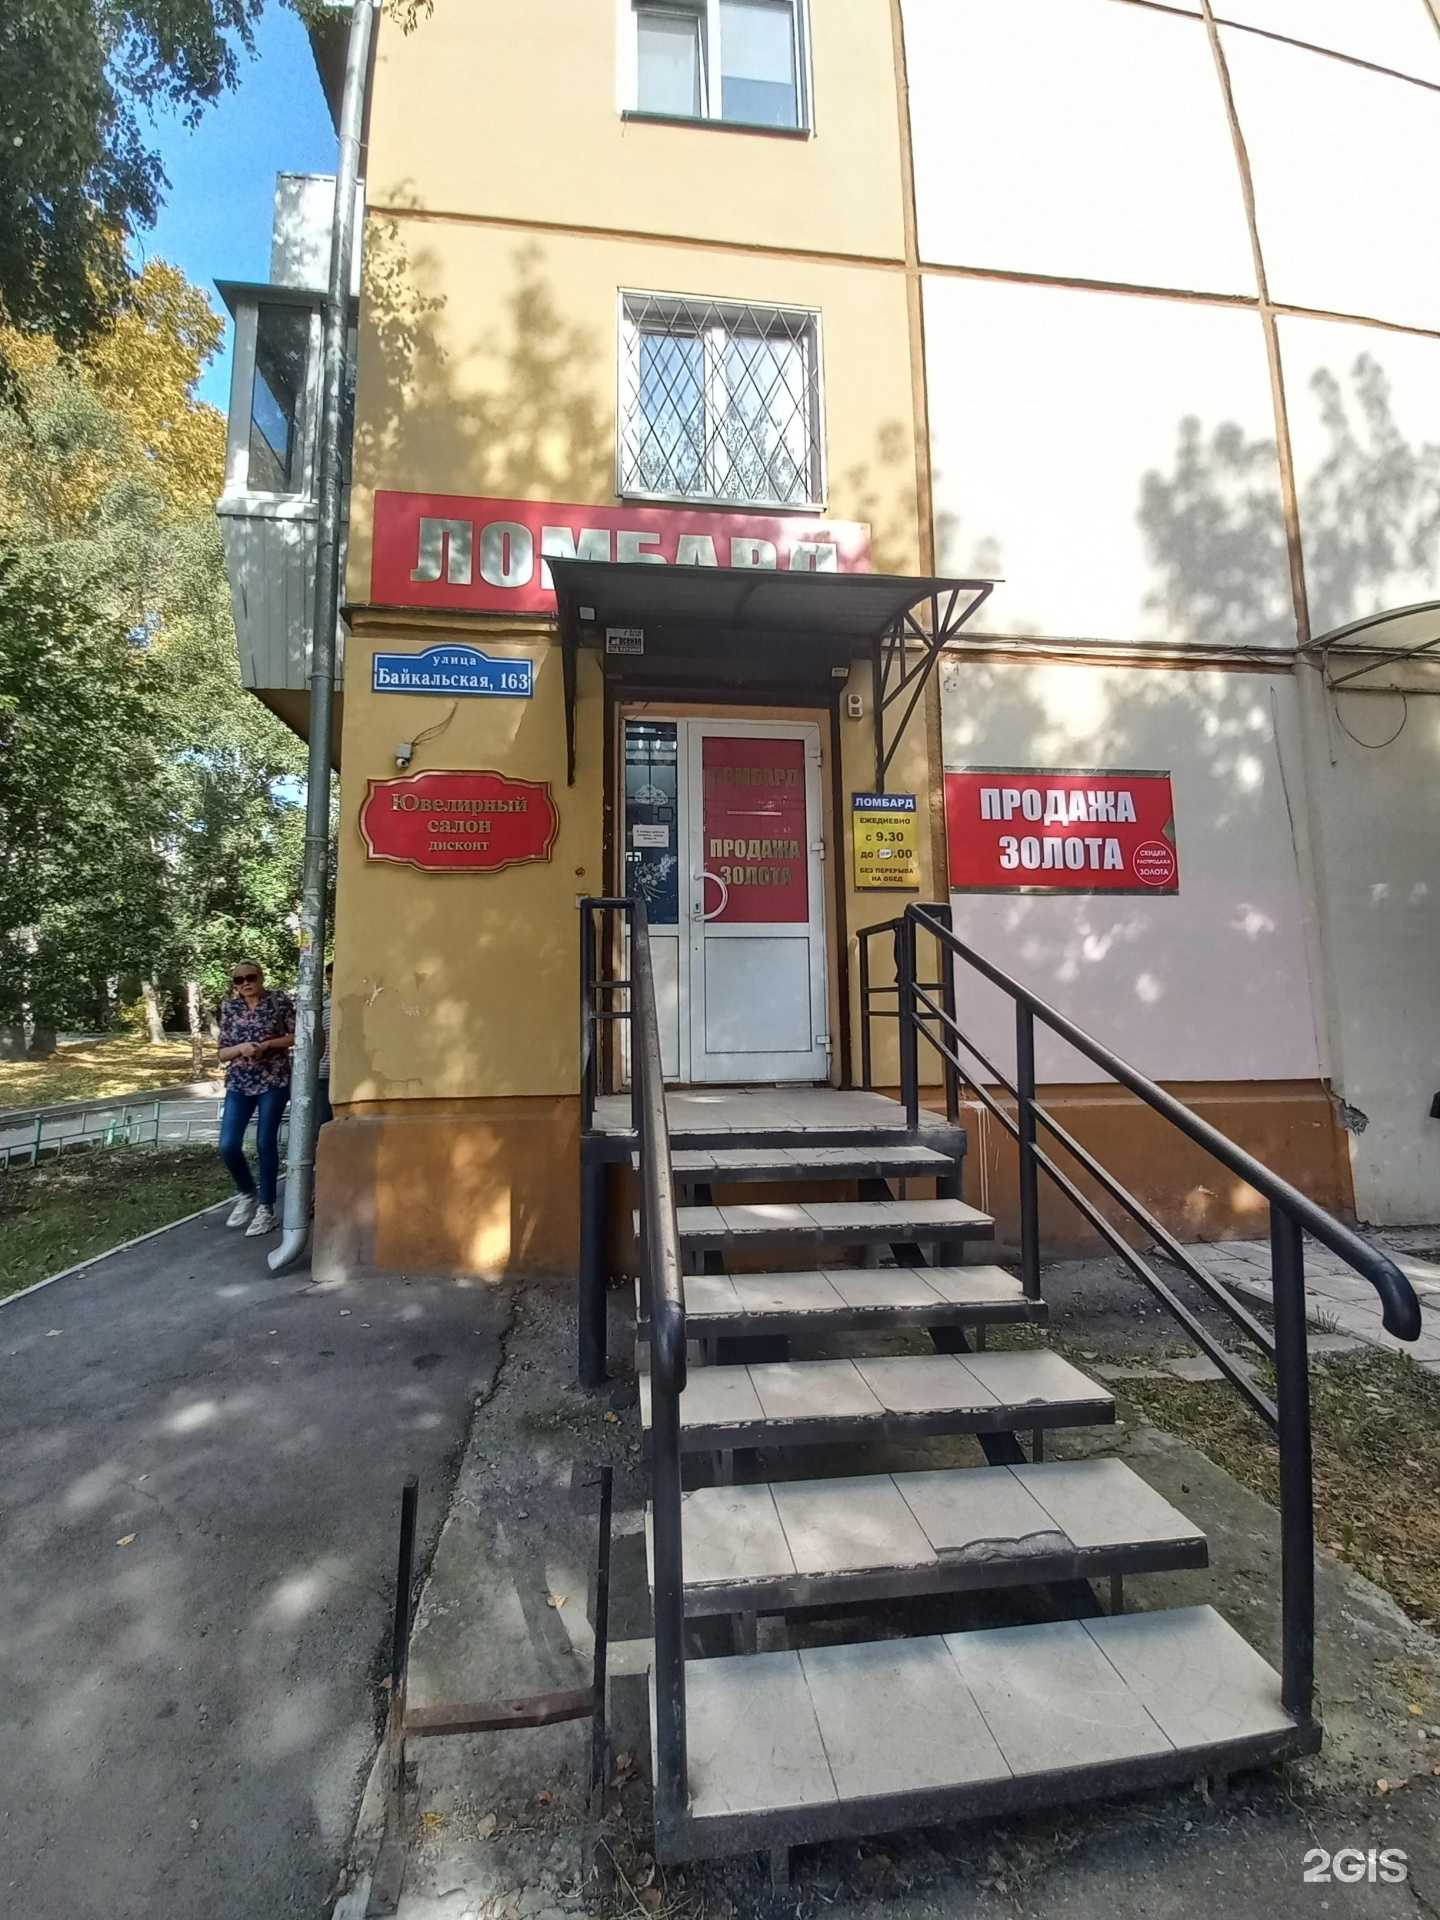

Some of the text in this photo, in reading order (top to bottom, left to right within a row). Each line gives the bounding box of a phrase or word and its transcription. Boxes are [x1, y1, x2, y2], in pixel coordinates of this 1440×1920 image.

[433, 653, 477, 667] улица
[378, 667, 529, 691] Байкальская, 163
[391, 793, 528, 816] Ювелирный
[855, 797, 914, 809] ЛОМБАРД
[980, 788, 1137, 827] ПРОДАЖА
[427, 817, 491, 834] салон
[859, 817, 911, 825] ЕЖЕДНЕВНО
[875, 831, 904, 842] 9.30
[428, 839, 489, 851] дисконт
[709, 838, 800, 861] ПРОДАЖА
[860, 850, 874, 859] до
[998, 836, 1125, 870] ЗОЛОТА
[1139, 849, 1167, 857] СКИДКИ
[719, 865, 793, 886] ЗОЛОТА
[1139, 868, 1169, 876] ЗОЛОТА
